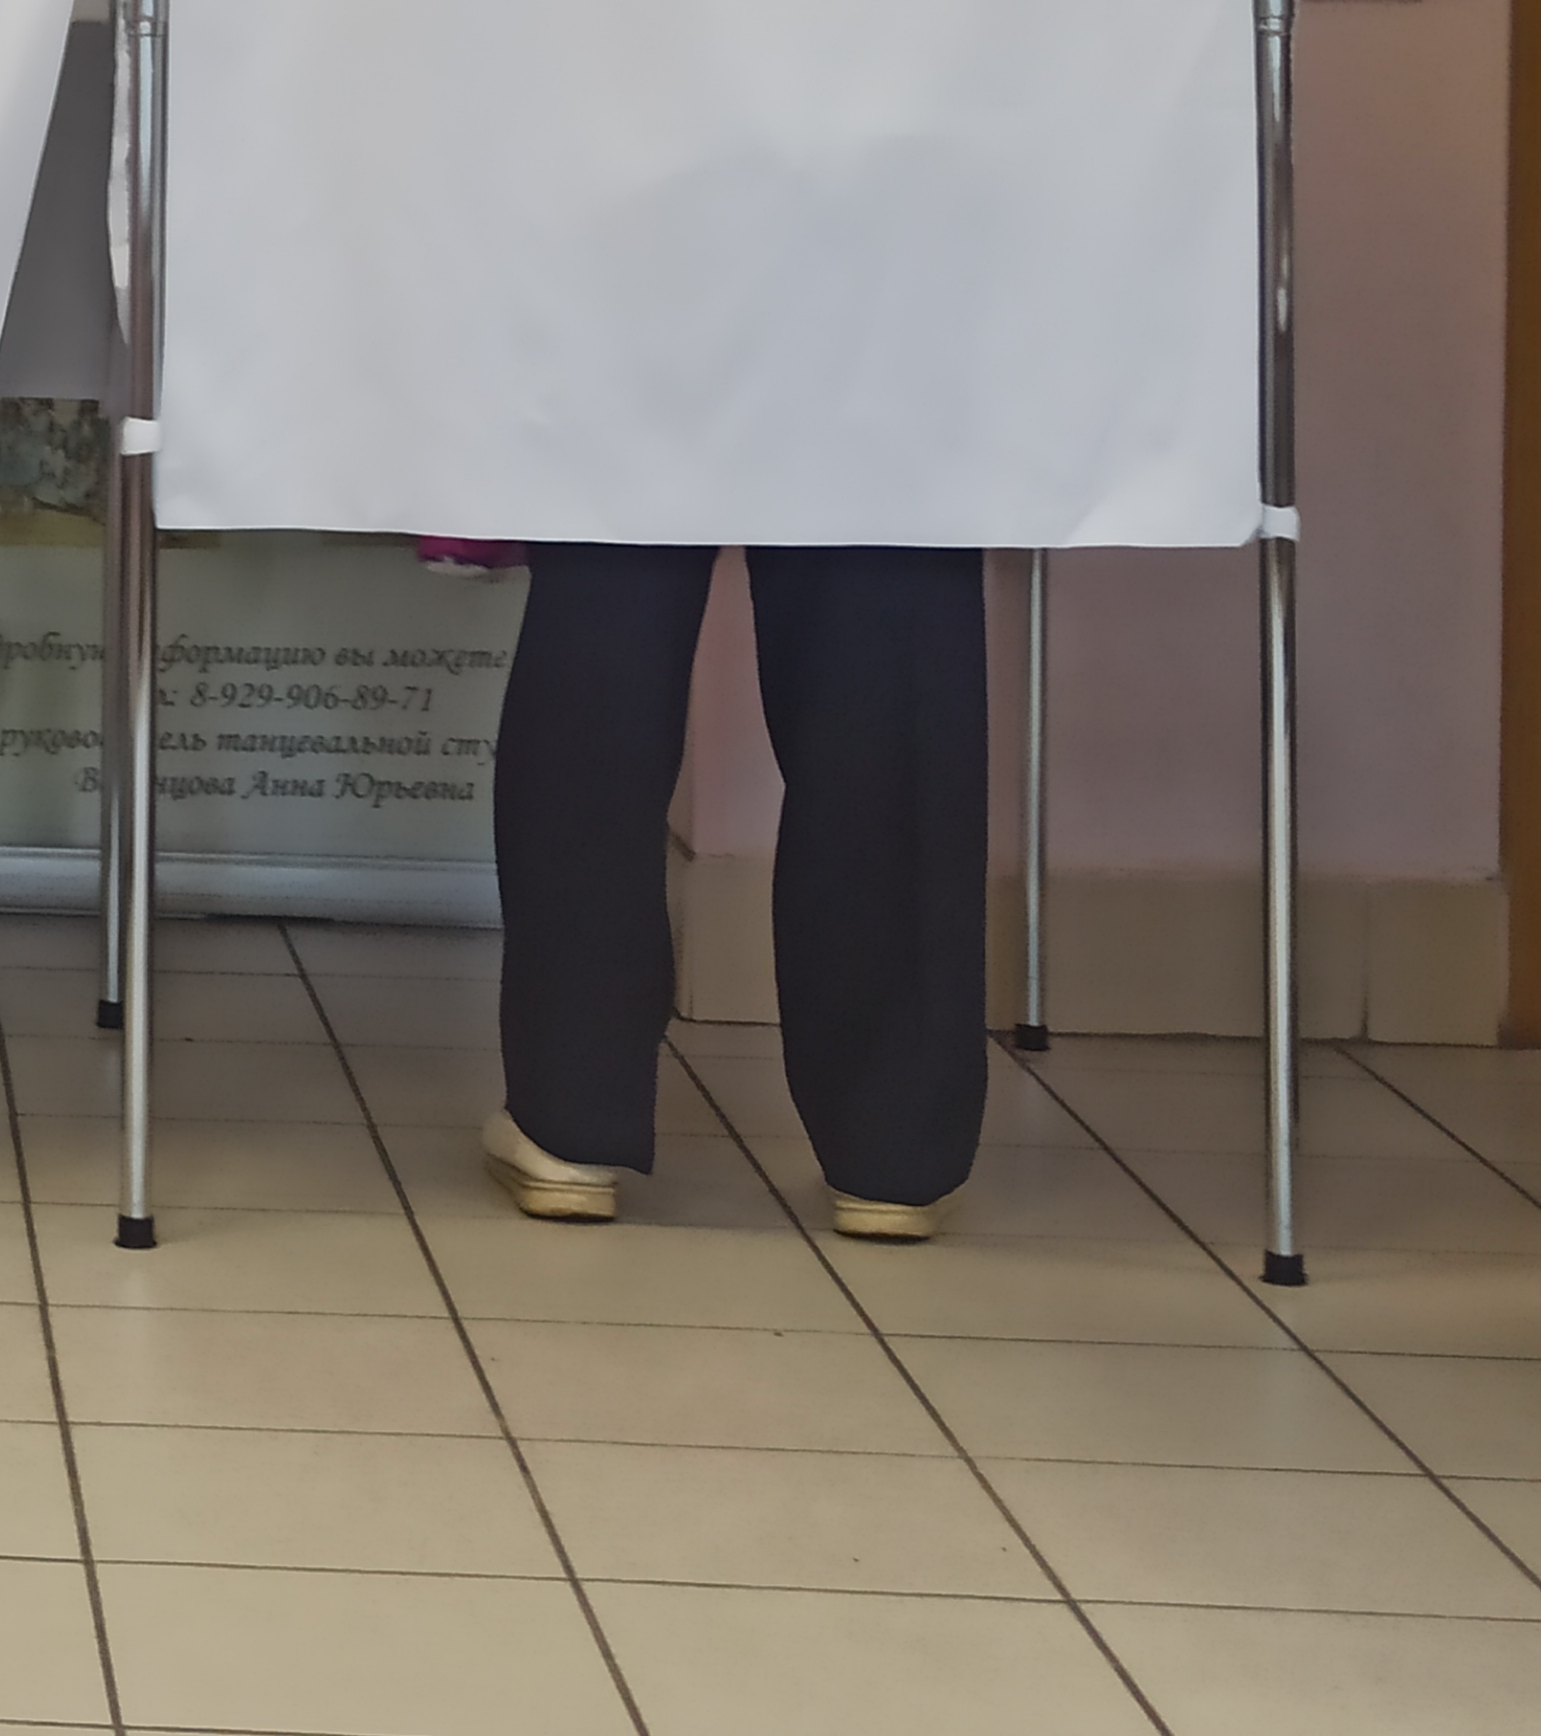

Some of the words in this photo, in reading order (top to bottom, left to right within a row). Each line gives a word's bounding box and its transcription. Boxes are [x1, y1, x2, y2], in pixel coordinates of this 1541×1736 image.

[333, 644, 375, 668] вы
[381, 644, 510, 676] можете
[189, 681, 434, 713] 8-929-906-89-71
[216, 730, 432, 759] танцевальной
[241, 769, 326, 800] Анна
[332, 772, 476, 808] Юрьевна
